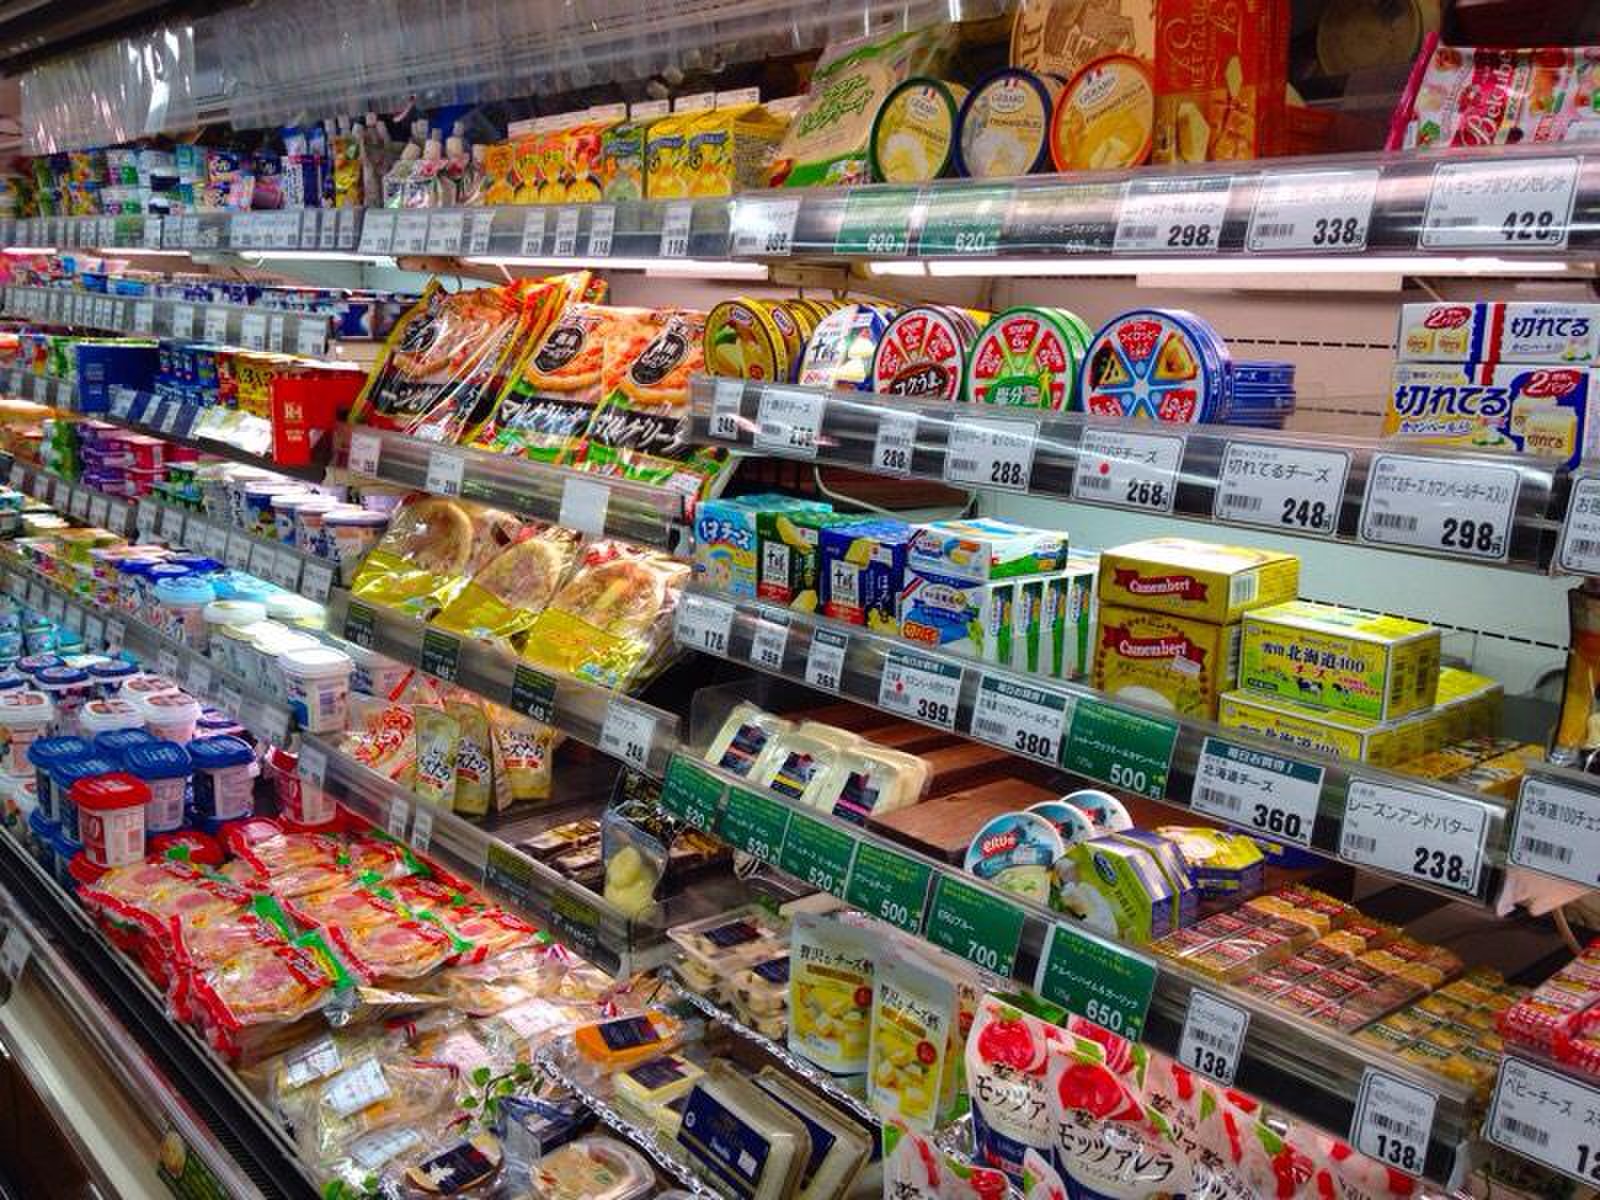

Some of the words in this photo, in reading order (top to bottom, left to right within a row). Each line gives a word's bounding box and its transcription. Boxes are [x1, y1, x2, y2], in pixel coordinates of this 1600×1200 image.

[1168, 225, 1210, 247] 298
[1313, 218, 1357, 245] 338
[1395, 384, 1509, 416] 切れてる
[1228, 458, 1330, 484] 切れてるチーズ
[1127, 481, 1163, 507] 268
[1282, 497, 1326, 528] 248
[1441, 516, 1494, 551] 298
[1129, 578, 1190, 593] Camembert
[1119, 638, 1187, 656] Camembert
[1015, 729, 1051, 757] 380
[1110, 763, 1146, 793] 500
[1253, 802, 1300, 838] 360
[1348, 799, 1474, 834] レーズンアンドバター
[1413, 846, 1463, 884] 238
[880, 899, 908, 925] 500
[967, 940, 998, 970] 700
[1087, 999, 1124, 1031] 650
[1194, 1046, 1228, 1079] 138
[1505, 1079, 1573, 1118] ベビーチーズ
[1377, 1134, 1417, 1171] 138
